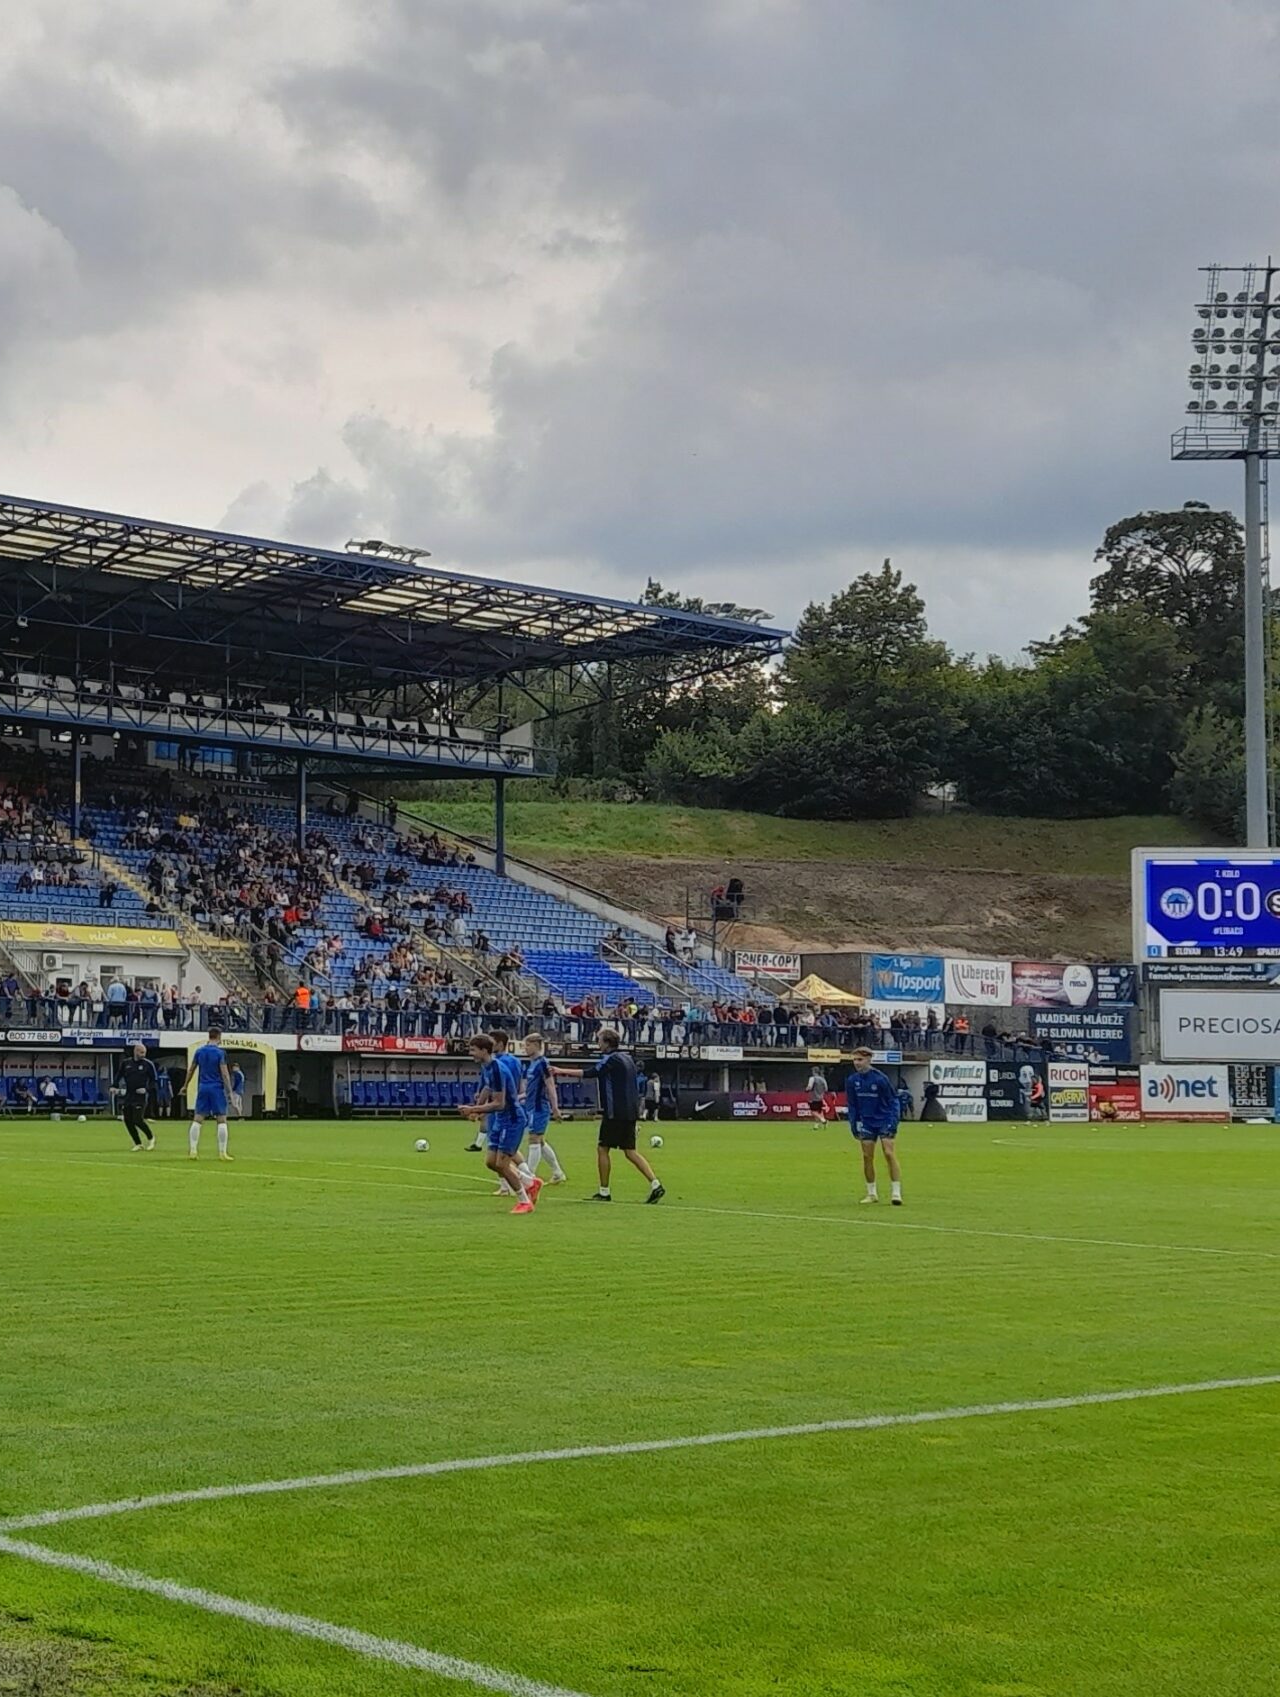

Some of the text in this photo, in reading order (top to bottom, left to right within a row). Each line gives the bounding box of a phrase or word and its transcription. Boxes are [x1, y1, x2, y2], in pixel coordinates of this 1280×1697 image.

[1197, 882, 1260, 921] 0:0
[1213, 946, 1244, 957] 13:49
[962, 965, 1006, 984] Liberecký
[892, 972, 941, 993] Tipsport
[981, 981, 999, 998] kraj
[1035, 1013, 1124, 1025] AKADEMIE MLÁDEŽE
[1036, 1028, 1123, 1039] FC SLOVAN LIBEREC
[1050, 1069, 1087, 1081] RICOH
